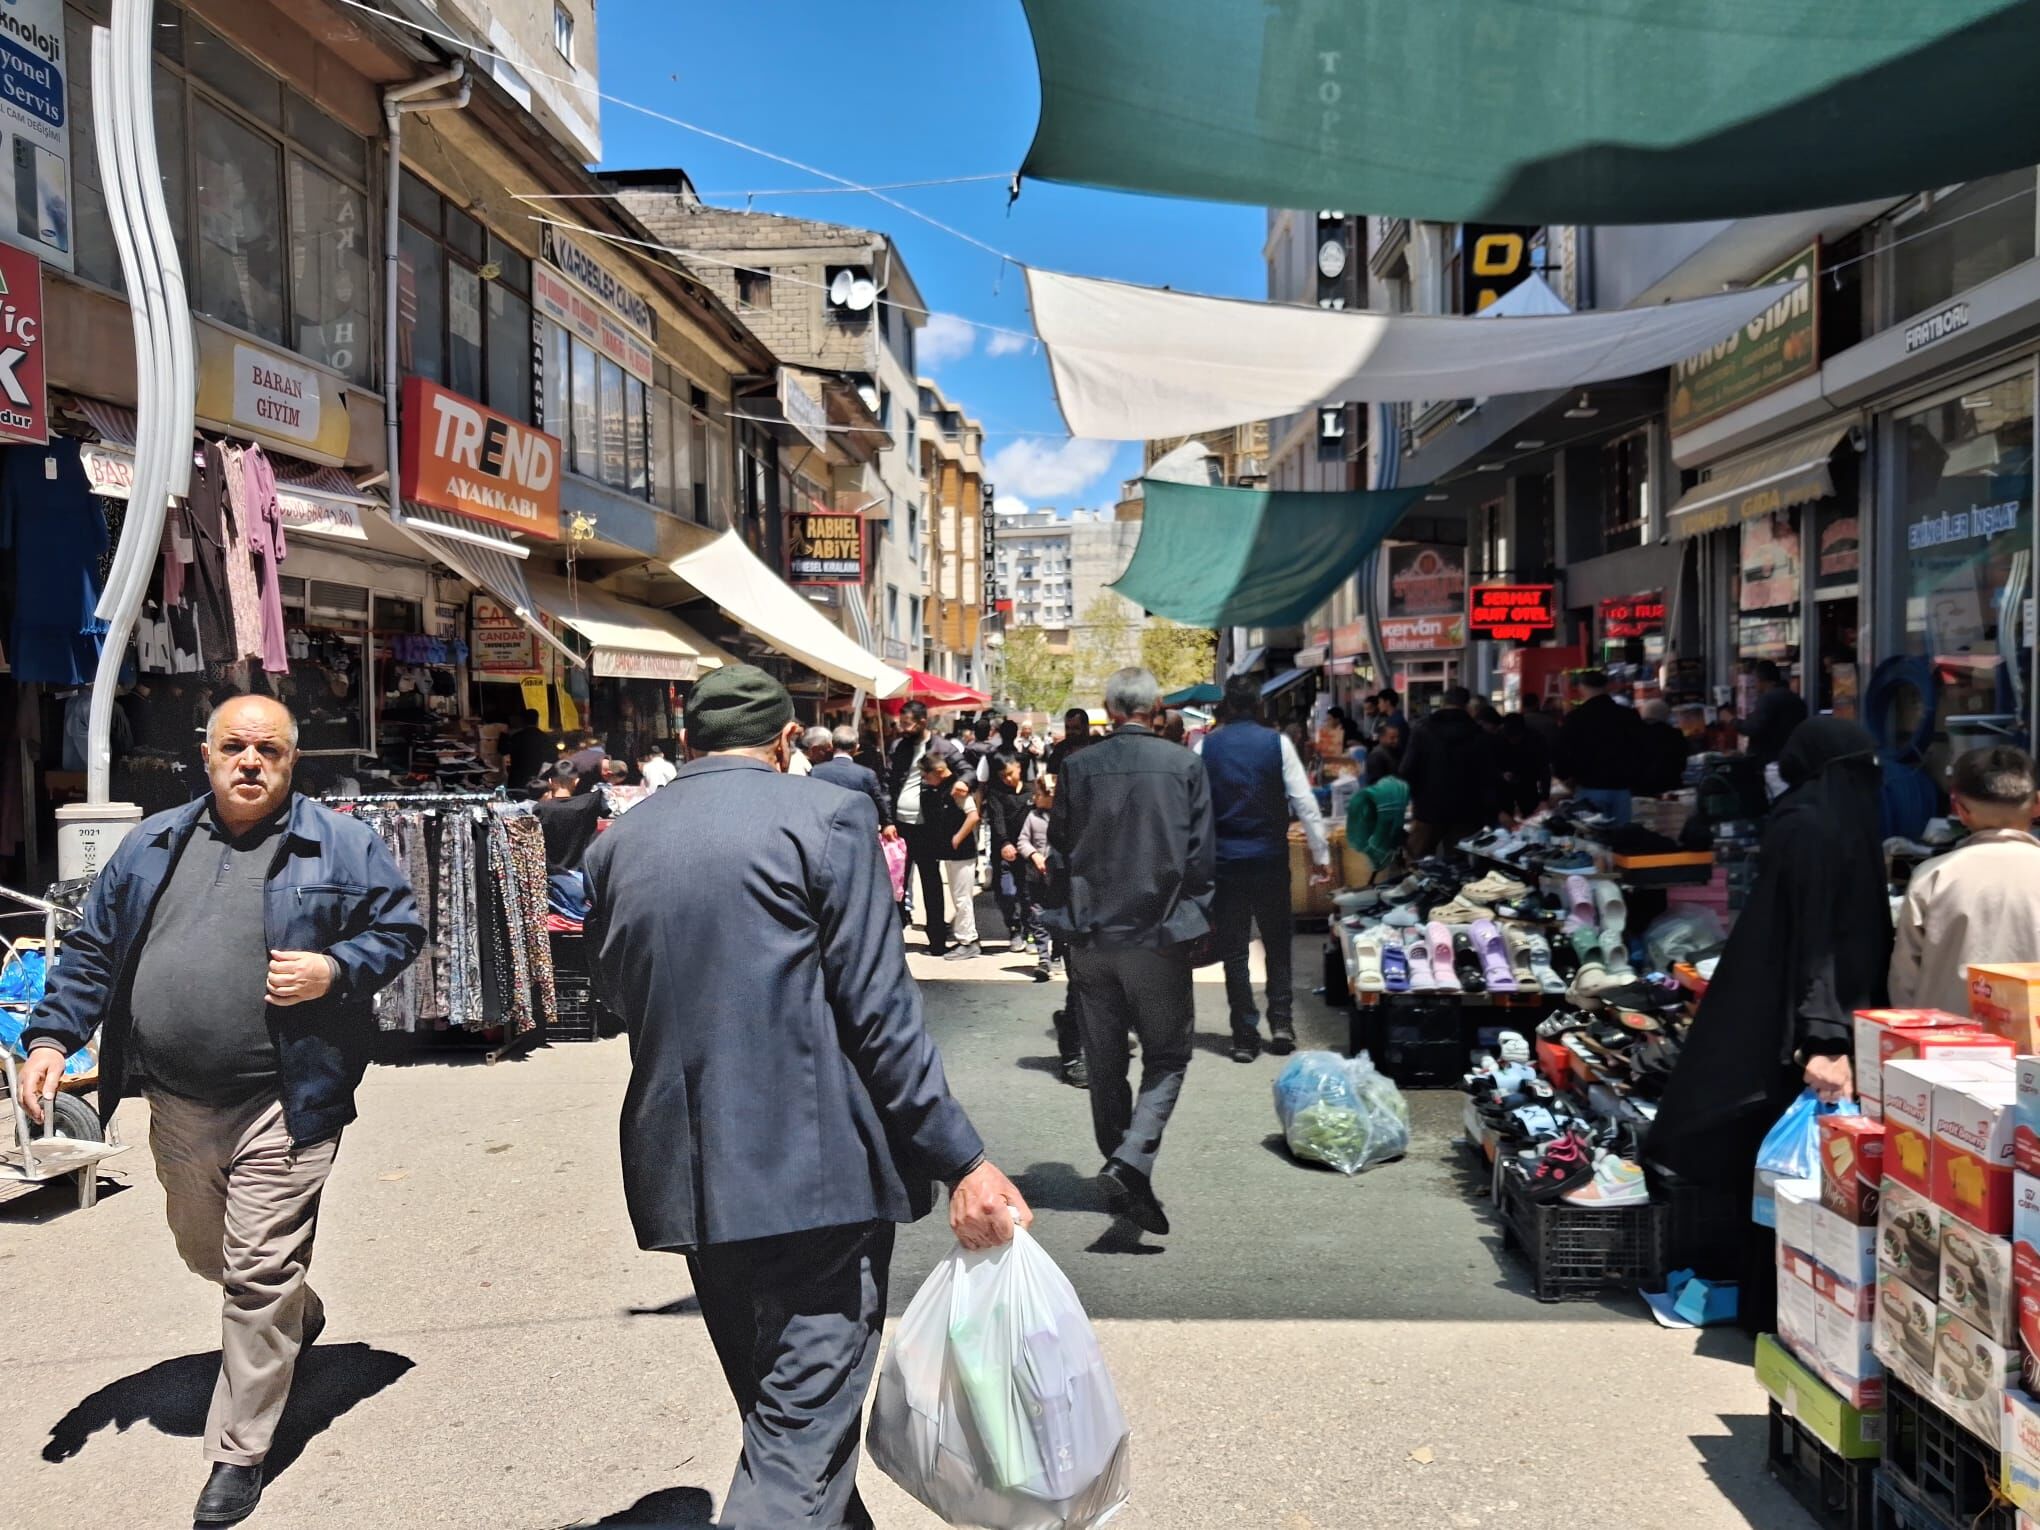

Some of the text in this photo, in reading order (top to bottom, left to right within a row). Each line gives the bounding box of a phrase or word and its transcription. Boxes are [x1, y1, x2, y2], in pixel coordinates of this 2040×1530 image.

[4, 73, 59, 120] Servis
[7, 106, 25, 124] CAM
[0, 300, 37, 347] iç
[252, 365, 302, 400] BARAN
[256, 395, 301, 428] GİYİM
[433, 393, 553, 492] TREND
[91, 456, 135, 487] BAR
[446, 476, 538, 521] AYAKKABI
[807, 517, 860, 539] RABHEL
[1970, 500, 2020, 541] İNŞAAT
[478, 631, 527, 642] CANDAR
[79, 828, 101, 837] 2021
